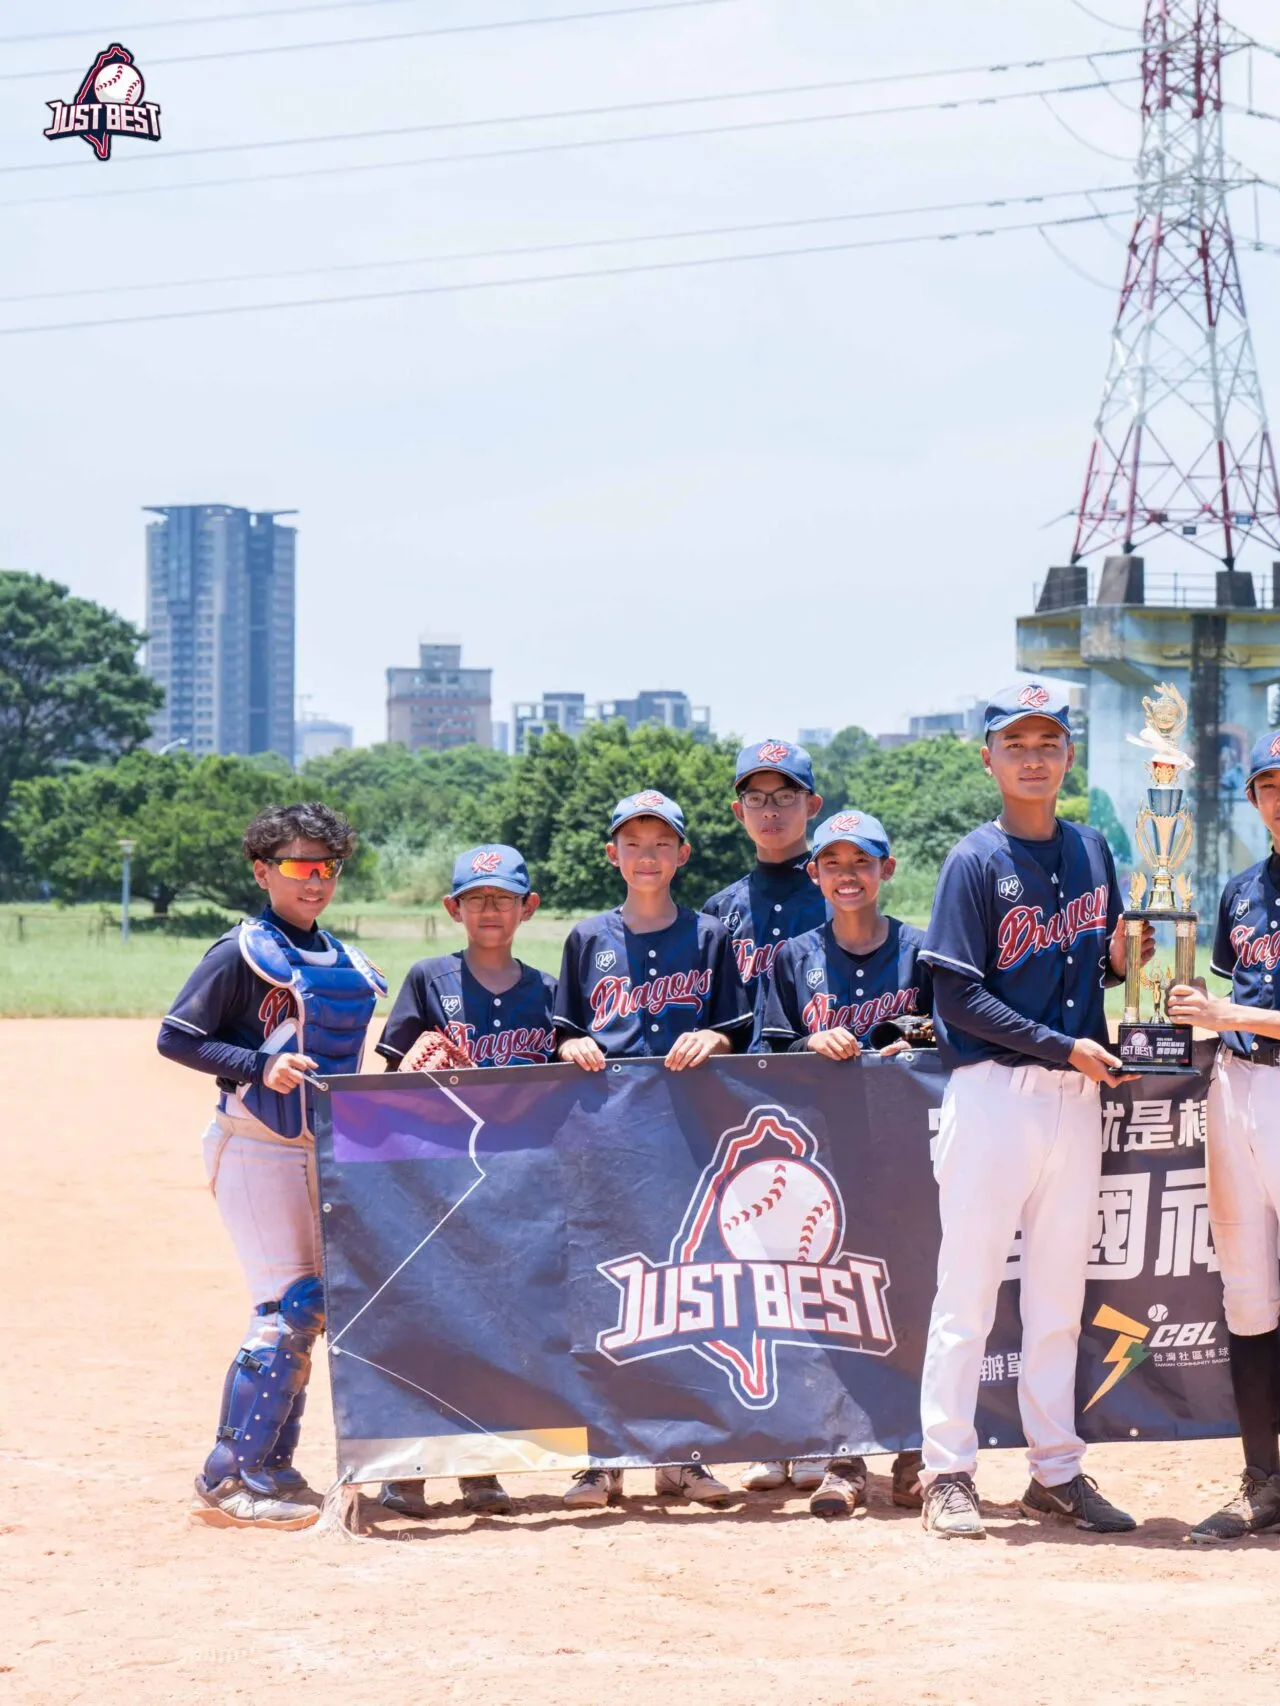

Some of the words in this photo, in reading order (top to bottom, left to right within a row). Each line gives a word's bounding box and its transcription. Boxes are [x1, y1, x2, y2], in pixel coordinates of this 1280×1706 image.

[997, 885, 1109, 970] Dragon
[590, 968, 713, 1032] Dragons
[602, 1260, 743, 1350] JUST
[748, 1260, 889, 1342] BEST
[1149, 1321, 1218, 1348] CBL
[980, 1352, 1022, 1382] 辦單
